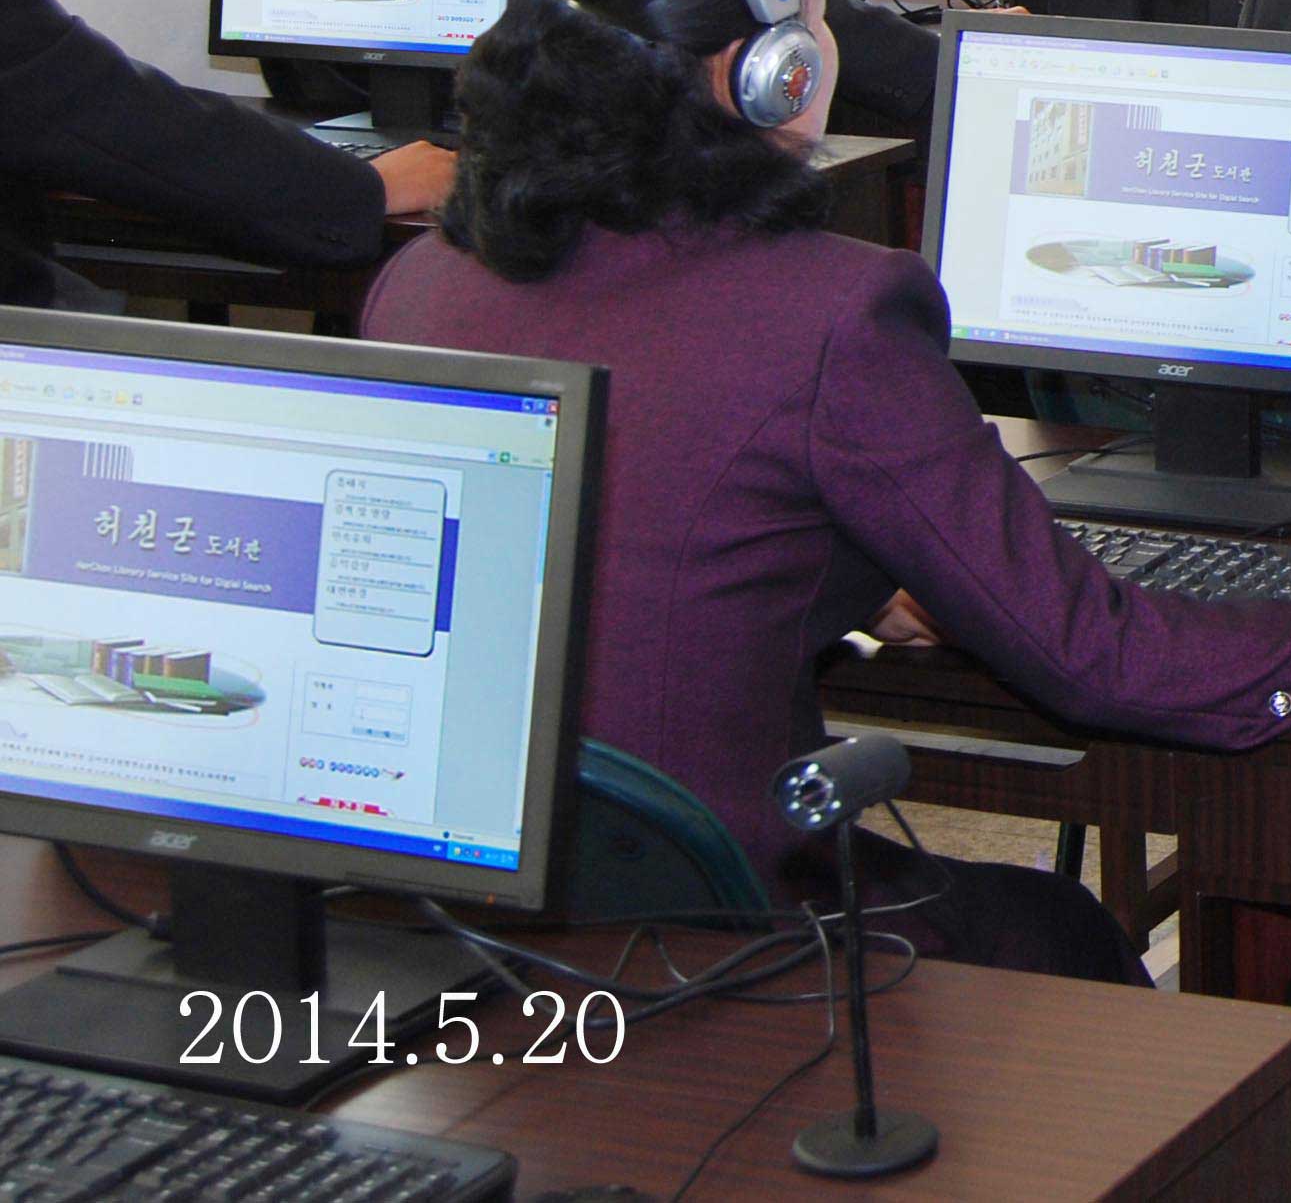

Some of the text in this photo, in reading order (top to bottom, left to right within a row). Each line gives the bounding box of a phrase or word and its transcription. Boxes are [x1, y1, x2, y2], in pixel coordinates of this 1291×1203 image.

[1134, 147, 1206, 178] 허천군
[1158, 364, 1193, 377] acer
[94, 505, 262, 562] 허천군 도서관
[150, 830, 198, 850] acer
